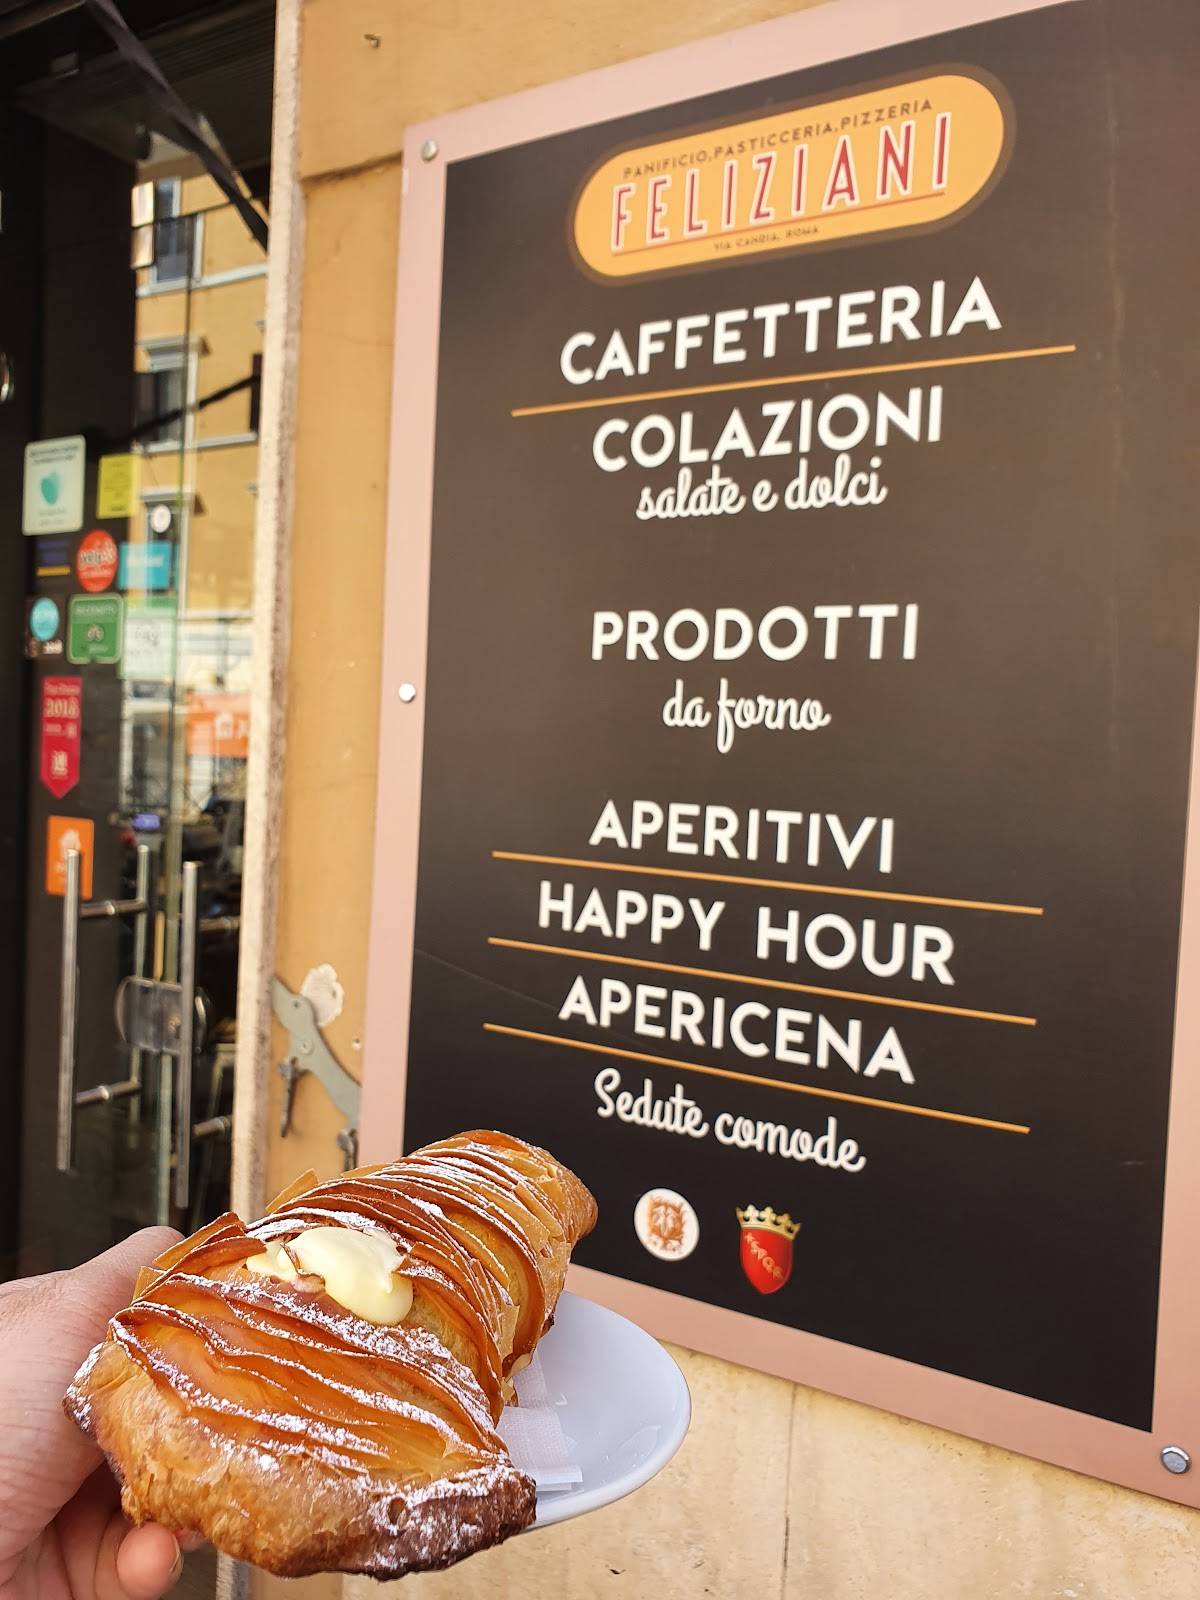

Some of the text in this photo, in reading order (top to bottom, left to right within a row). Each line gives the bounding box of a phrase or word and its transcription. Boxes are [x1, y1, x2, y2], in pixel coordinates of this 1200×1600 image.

[611, 111, 952, 255] FELIZIANI
[560, 276, 1002, 385] CAFFETTERIA
[592, 385, 943, 472] COLAZIONI
[635, 452, 888, 520] salate e dolci
[591, 603, 919, 662] PRODOTTI
[662, 678, 832, 754] da forno
[589, 800, 894, 874] APERITIVI
[539, 880, 955, 985] HAPPY HOUR
[558, 976, 915, 1084] APERICENA
[594, 1067, 866, 1172] Sedute comode
